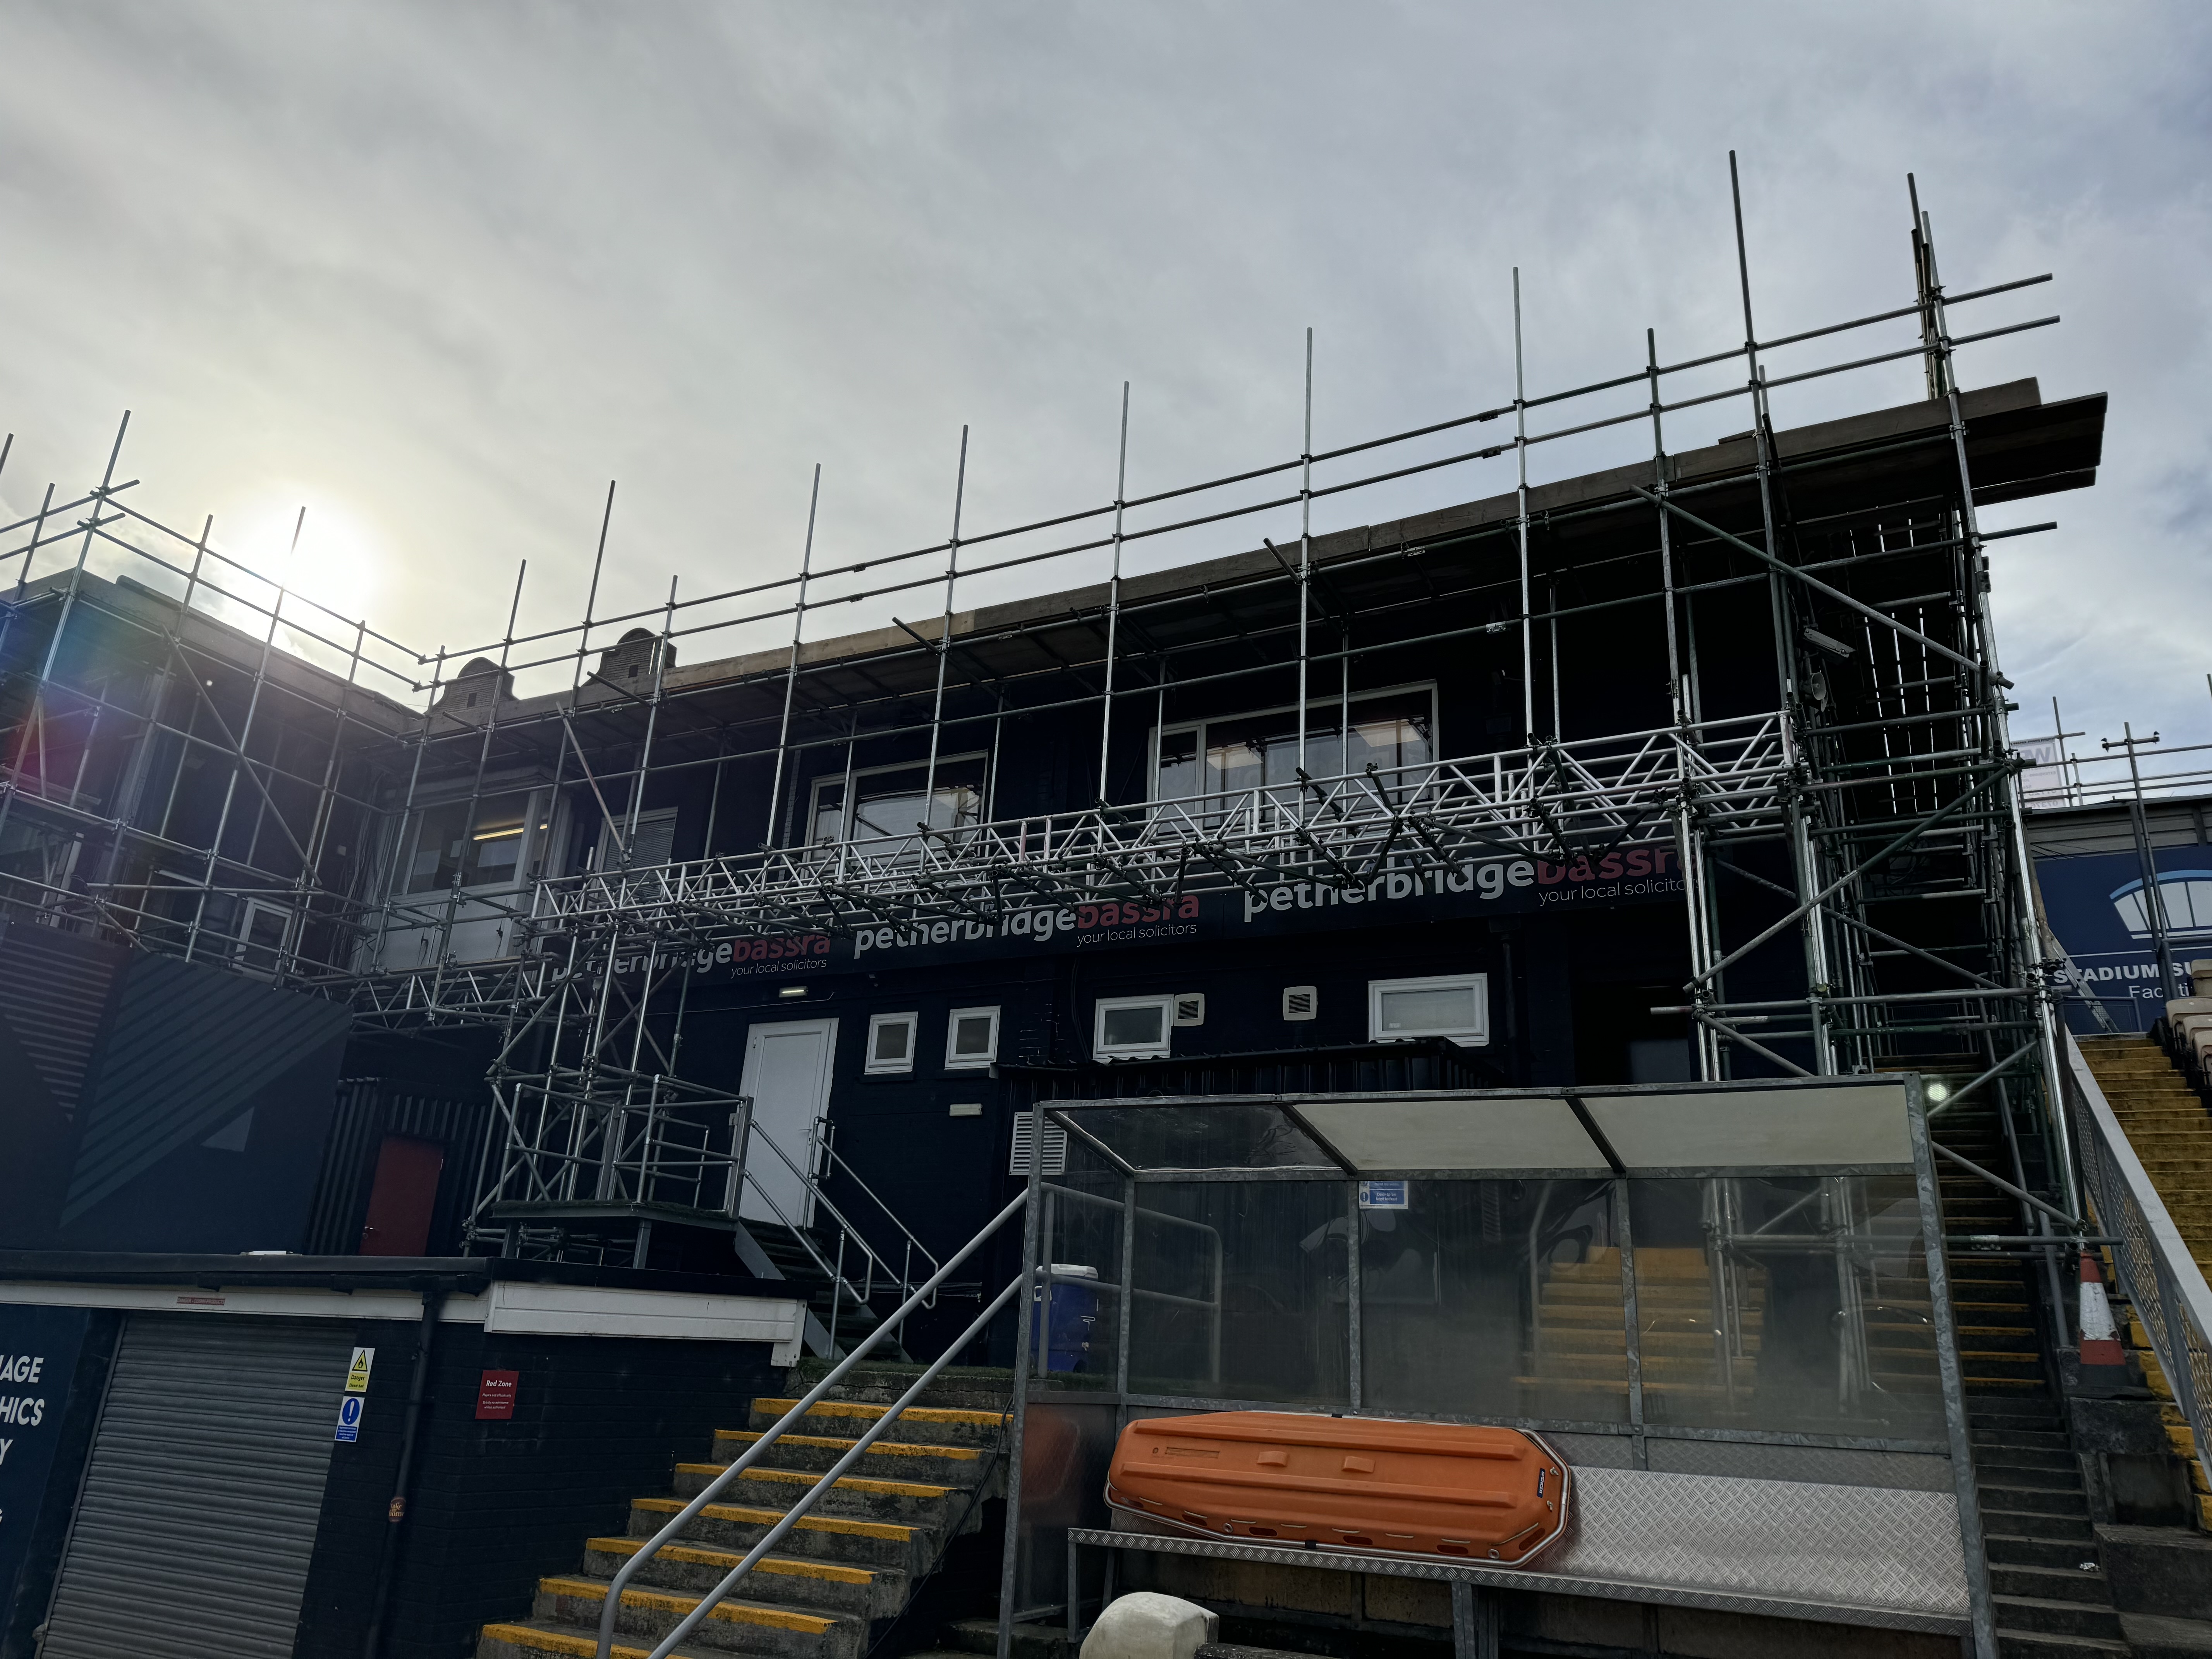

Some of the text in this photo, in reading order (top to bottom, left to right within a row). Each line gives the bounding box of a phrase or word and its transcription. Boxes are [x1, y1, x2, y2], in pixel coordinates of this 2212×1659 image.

[1539, 878, 1699, 906] your local solicito
[1077, 924, 1197, 947] your local solicitors
[730, 959, 827, 979] your local solicitors
[2054, 964, 2160, 984] SADIUM
